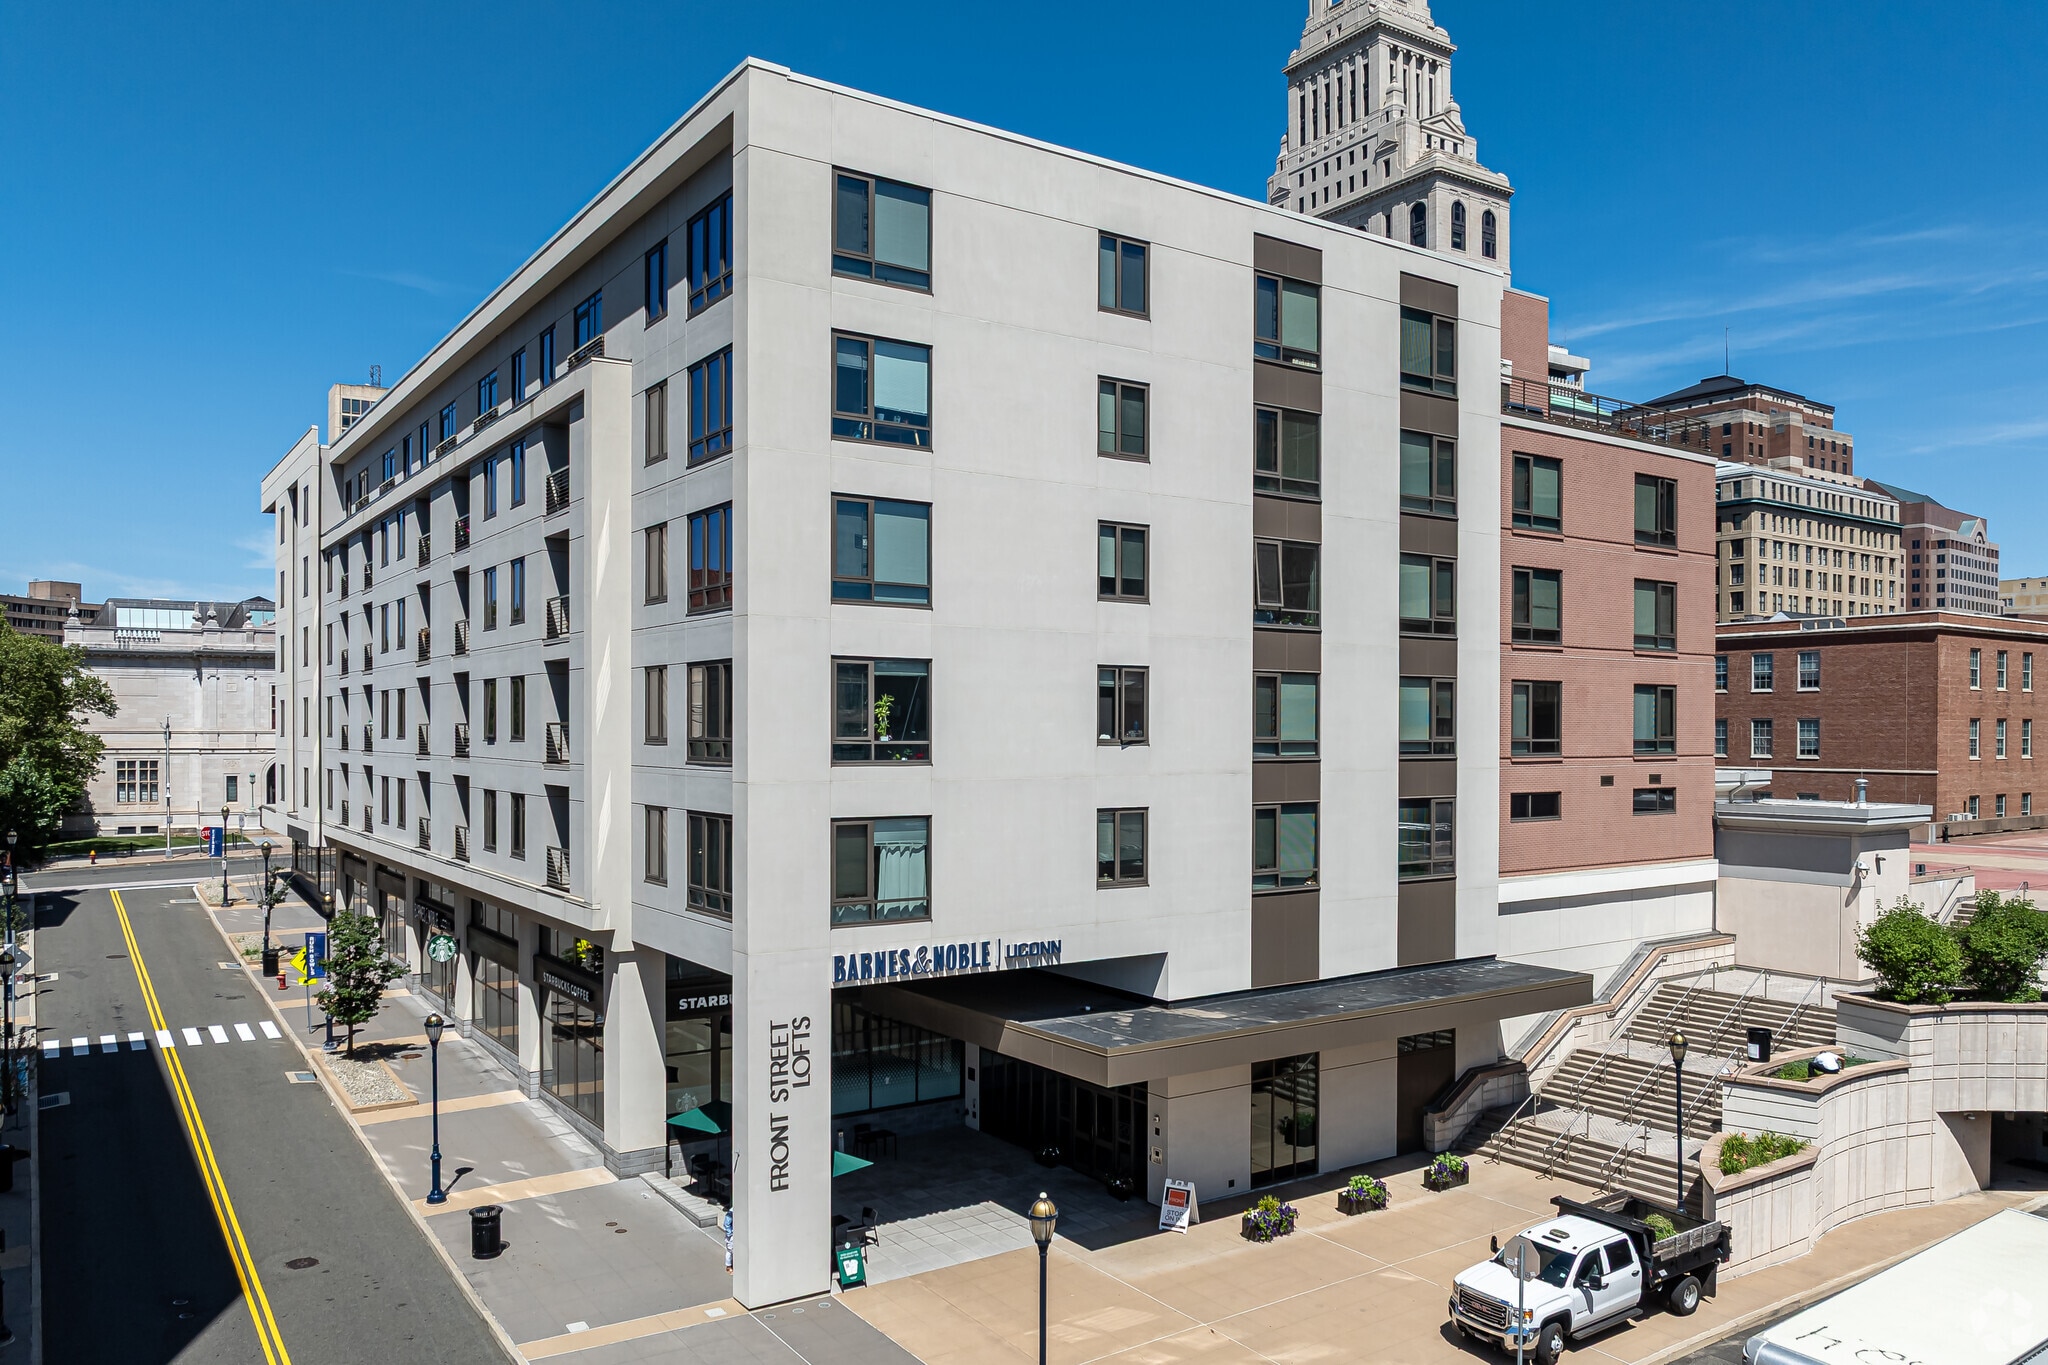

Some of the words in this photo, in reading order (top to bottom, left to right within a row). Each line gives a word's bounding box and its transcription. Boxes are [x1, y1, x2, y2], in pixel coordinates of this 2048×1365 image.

[1006, 939, 1062, 959] UCONN
[542, 971, 571, 994] STARBUCKS
[570, 982, 590, 1003] COFFEE
[769, 1020, 790, 1103] STREET
[791, 1016, 811, 1089] LOFTS
[769, 1112, 790, 1192] FRONT
